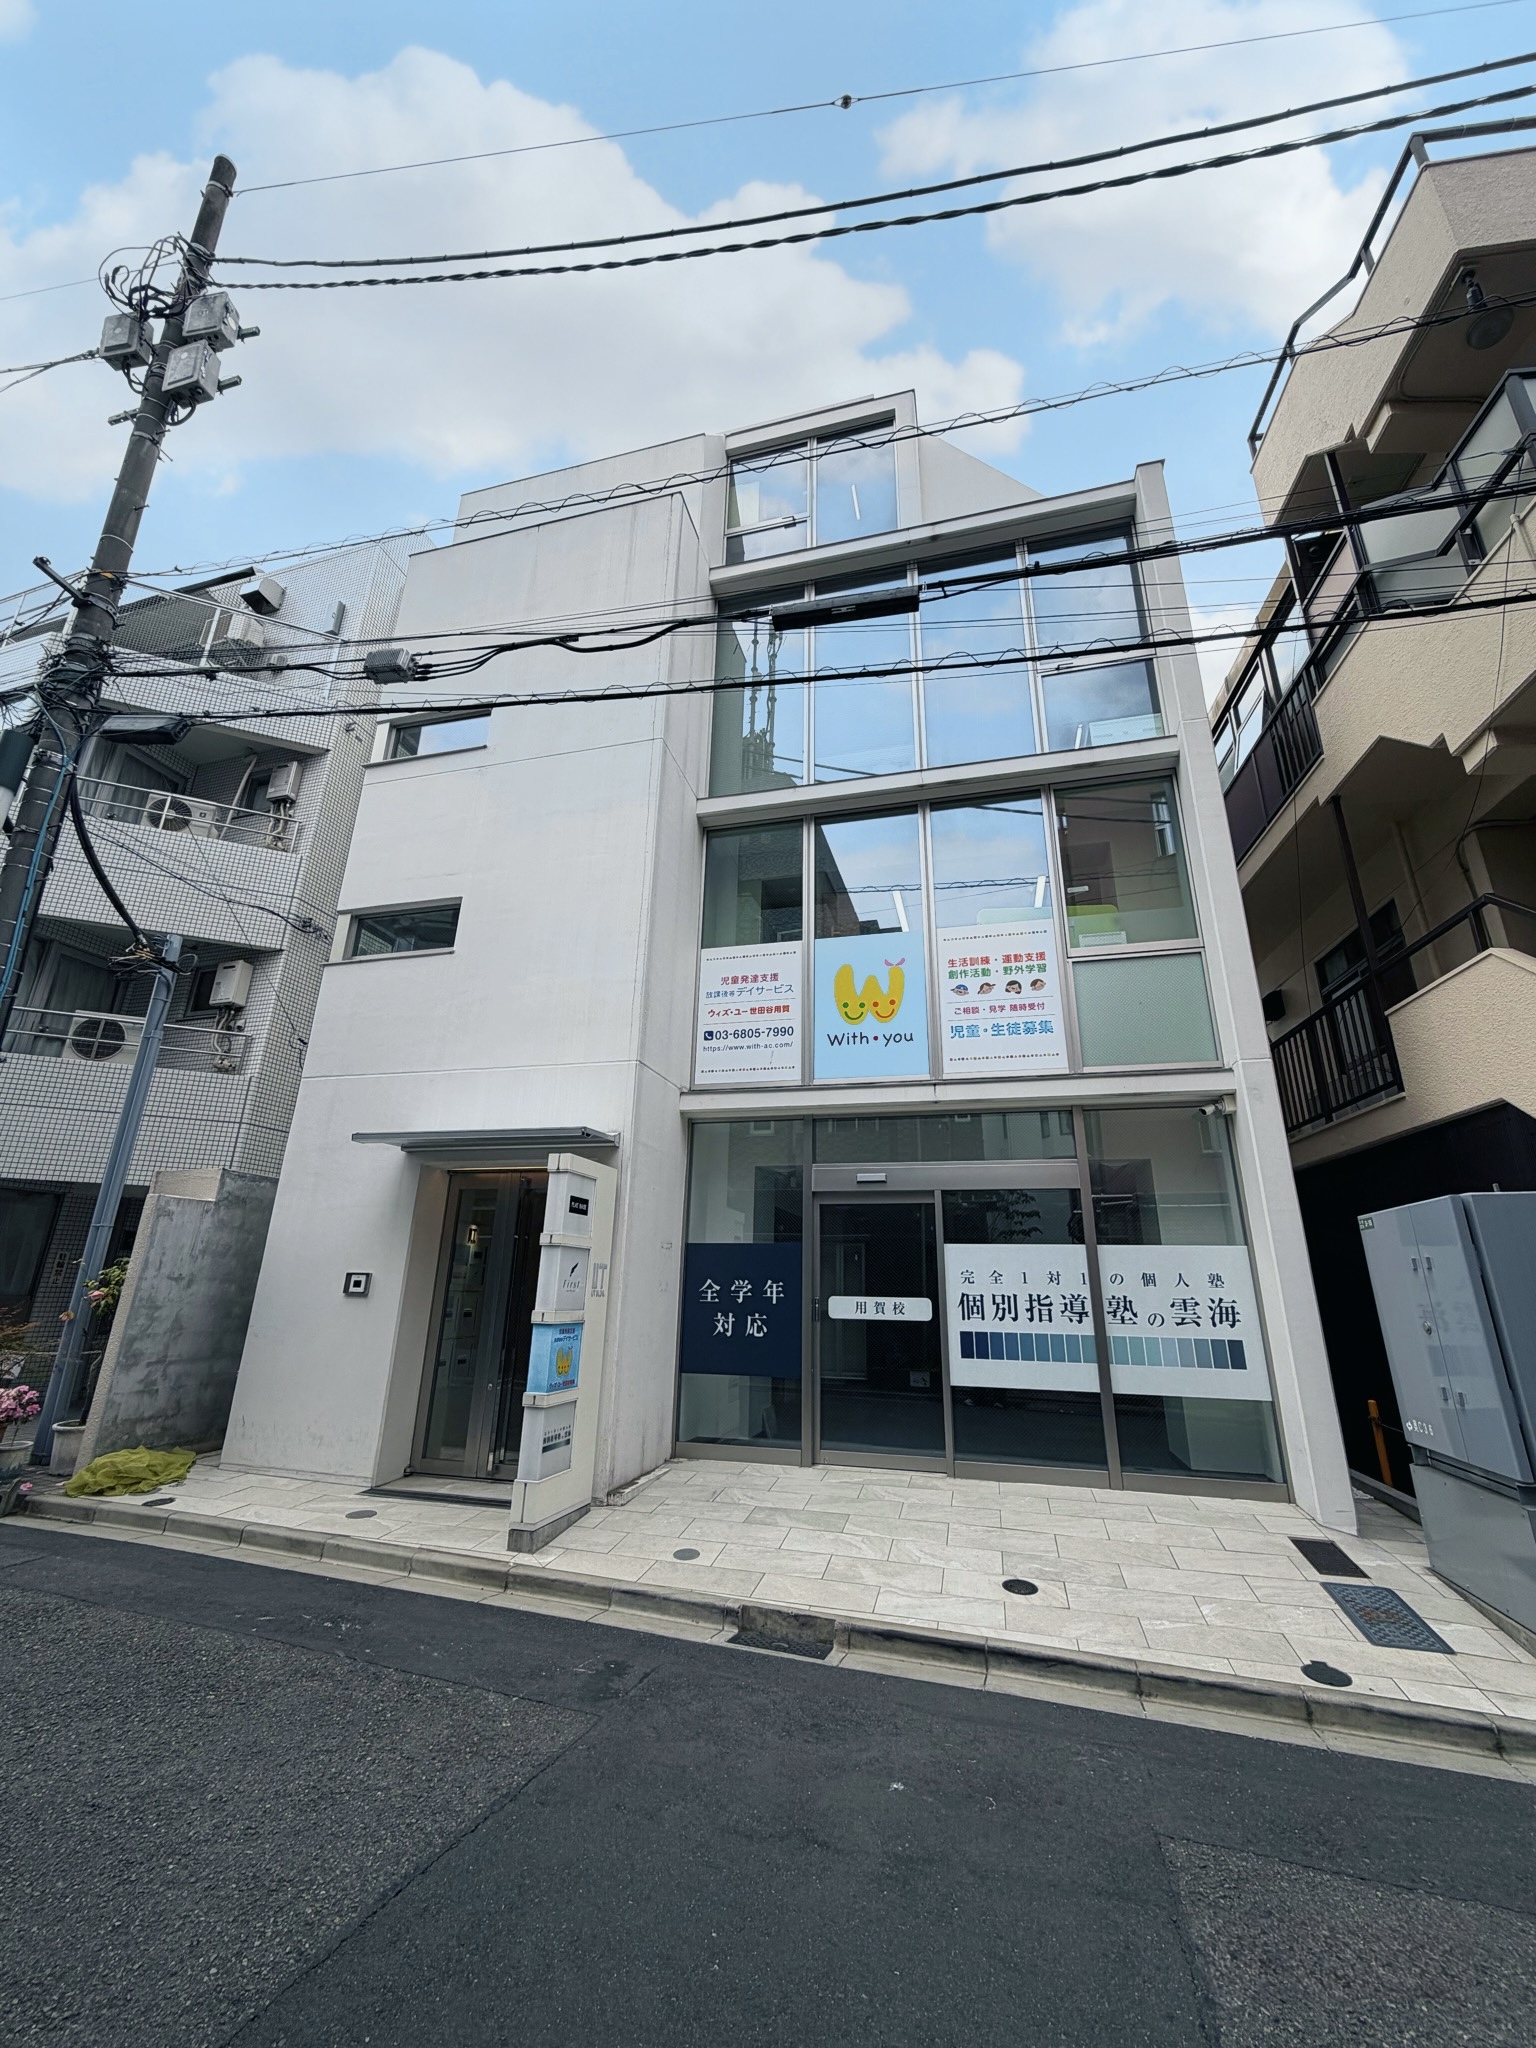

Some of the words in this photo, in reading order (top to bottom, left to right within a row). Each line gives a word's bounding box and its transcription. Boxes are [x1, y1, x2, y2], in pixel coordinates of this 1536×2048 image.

[720, 972, 779, 986] 児童発達支援
[715, 1026, 794, 1040] 03-6805-7990
[950, 1020, 1054, 1039] 児童・生徒募集
[702, 1041, 793, 1052] https://www.with-ac.com/
[699, 1279, 785, 1304] 全学年
[854, 1300, 906, 1315] 用賀校
[957, 1292, 1242, 1329] 個別指導塾の雲海
[713, 1312, 768, 1337] 対応
